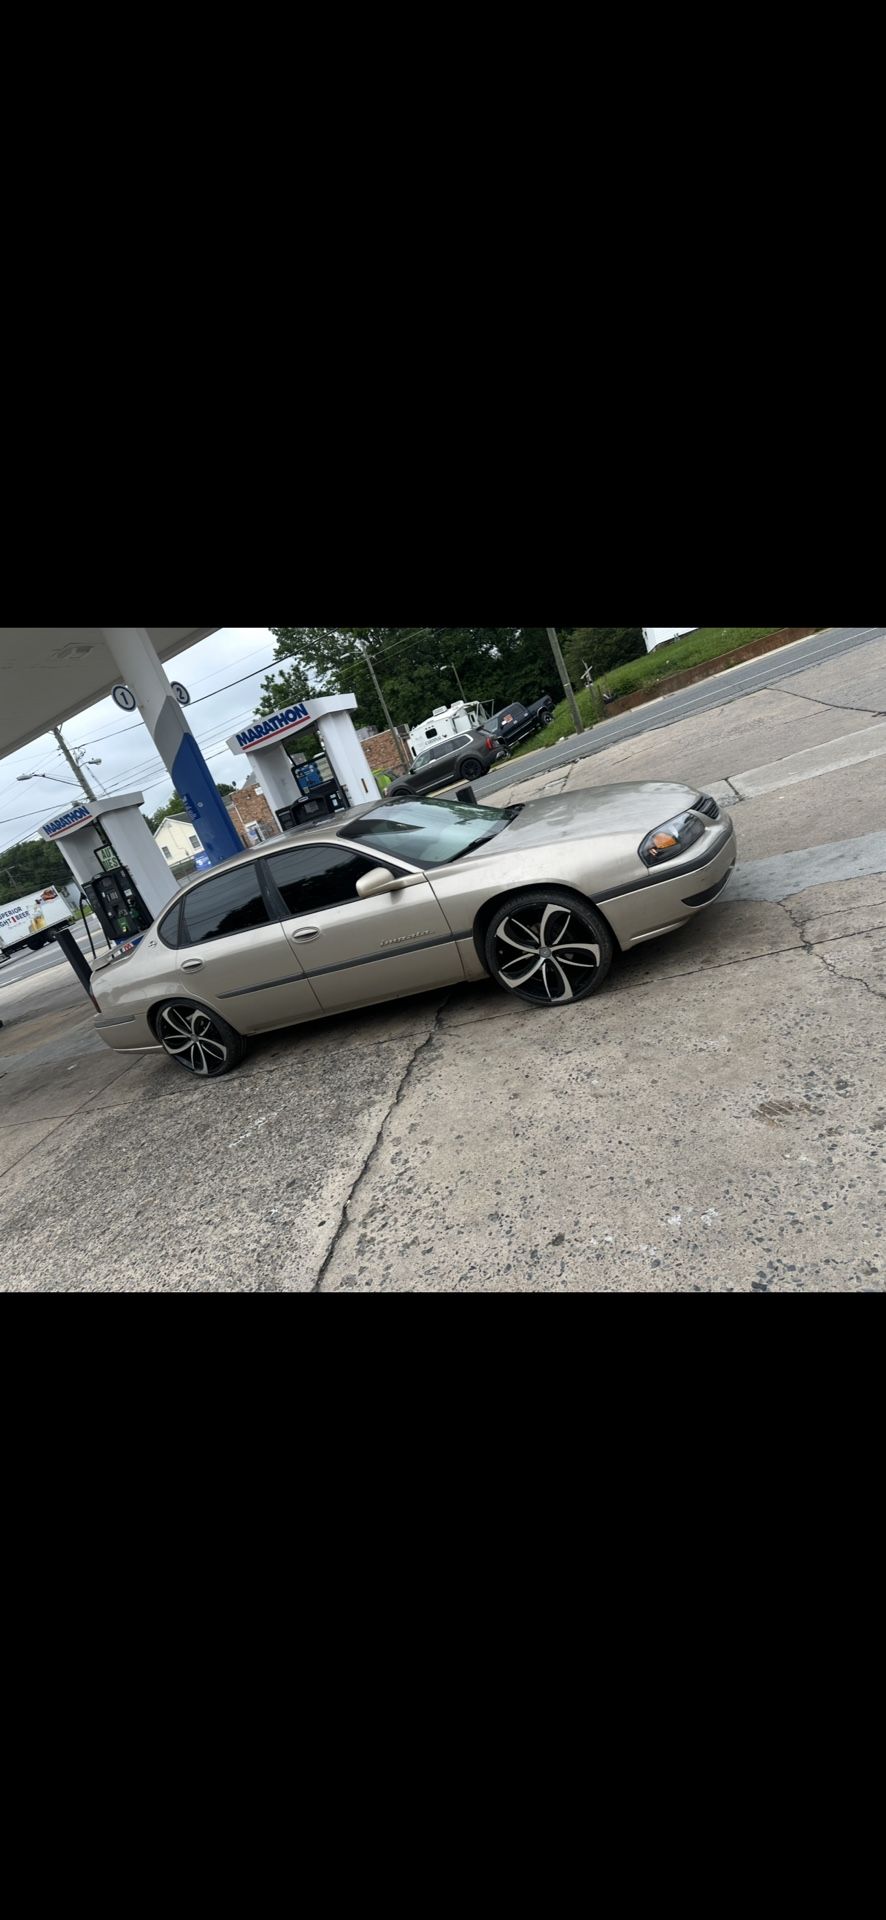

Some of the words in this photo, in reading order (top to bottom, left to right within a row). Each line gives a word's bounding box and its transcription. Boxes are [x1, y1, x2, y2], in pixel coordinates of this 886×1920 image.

[119, 691, 129, 706] 1
[175, 687, 185, 700] 2
[236, 703, 309, 746] MARATHON
[42, 805, 90, 835] MARATHON
[15, 910, 30, 921] BEER
